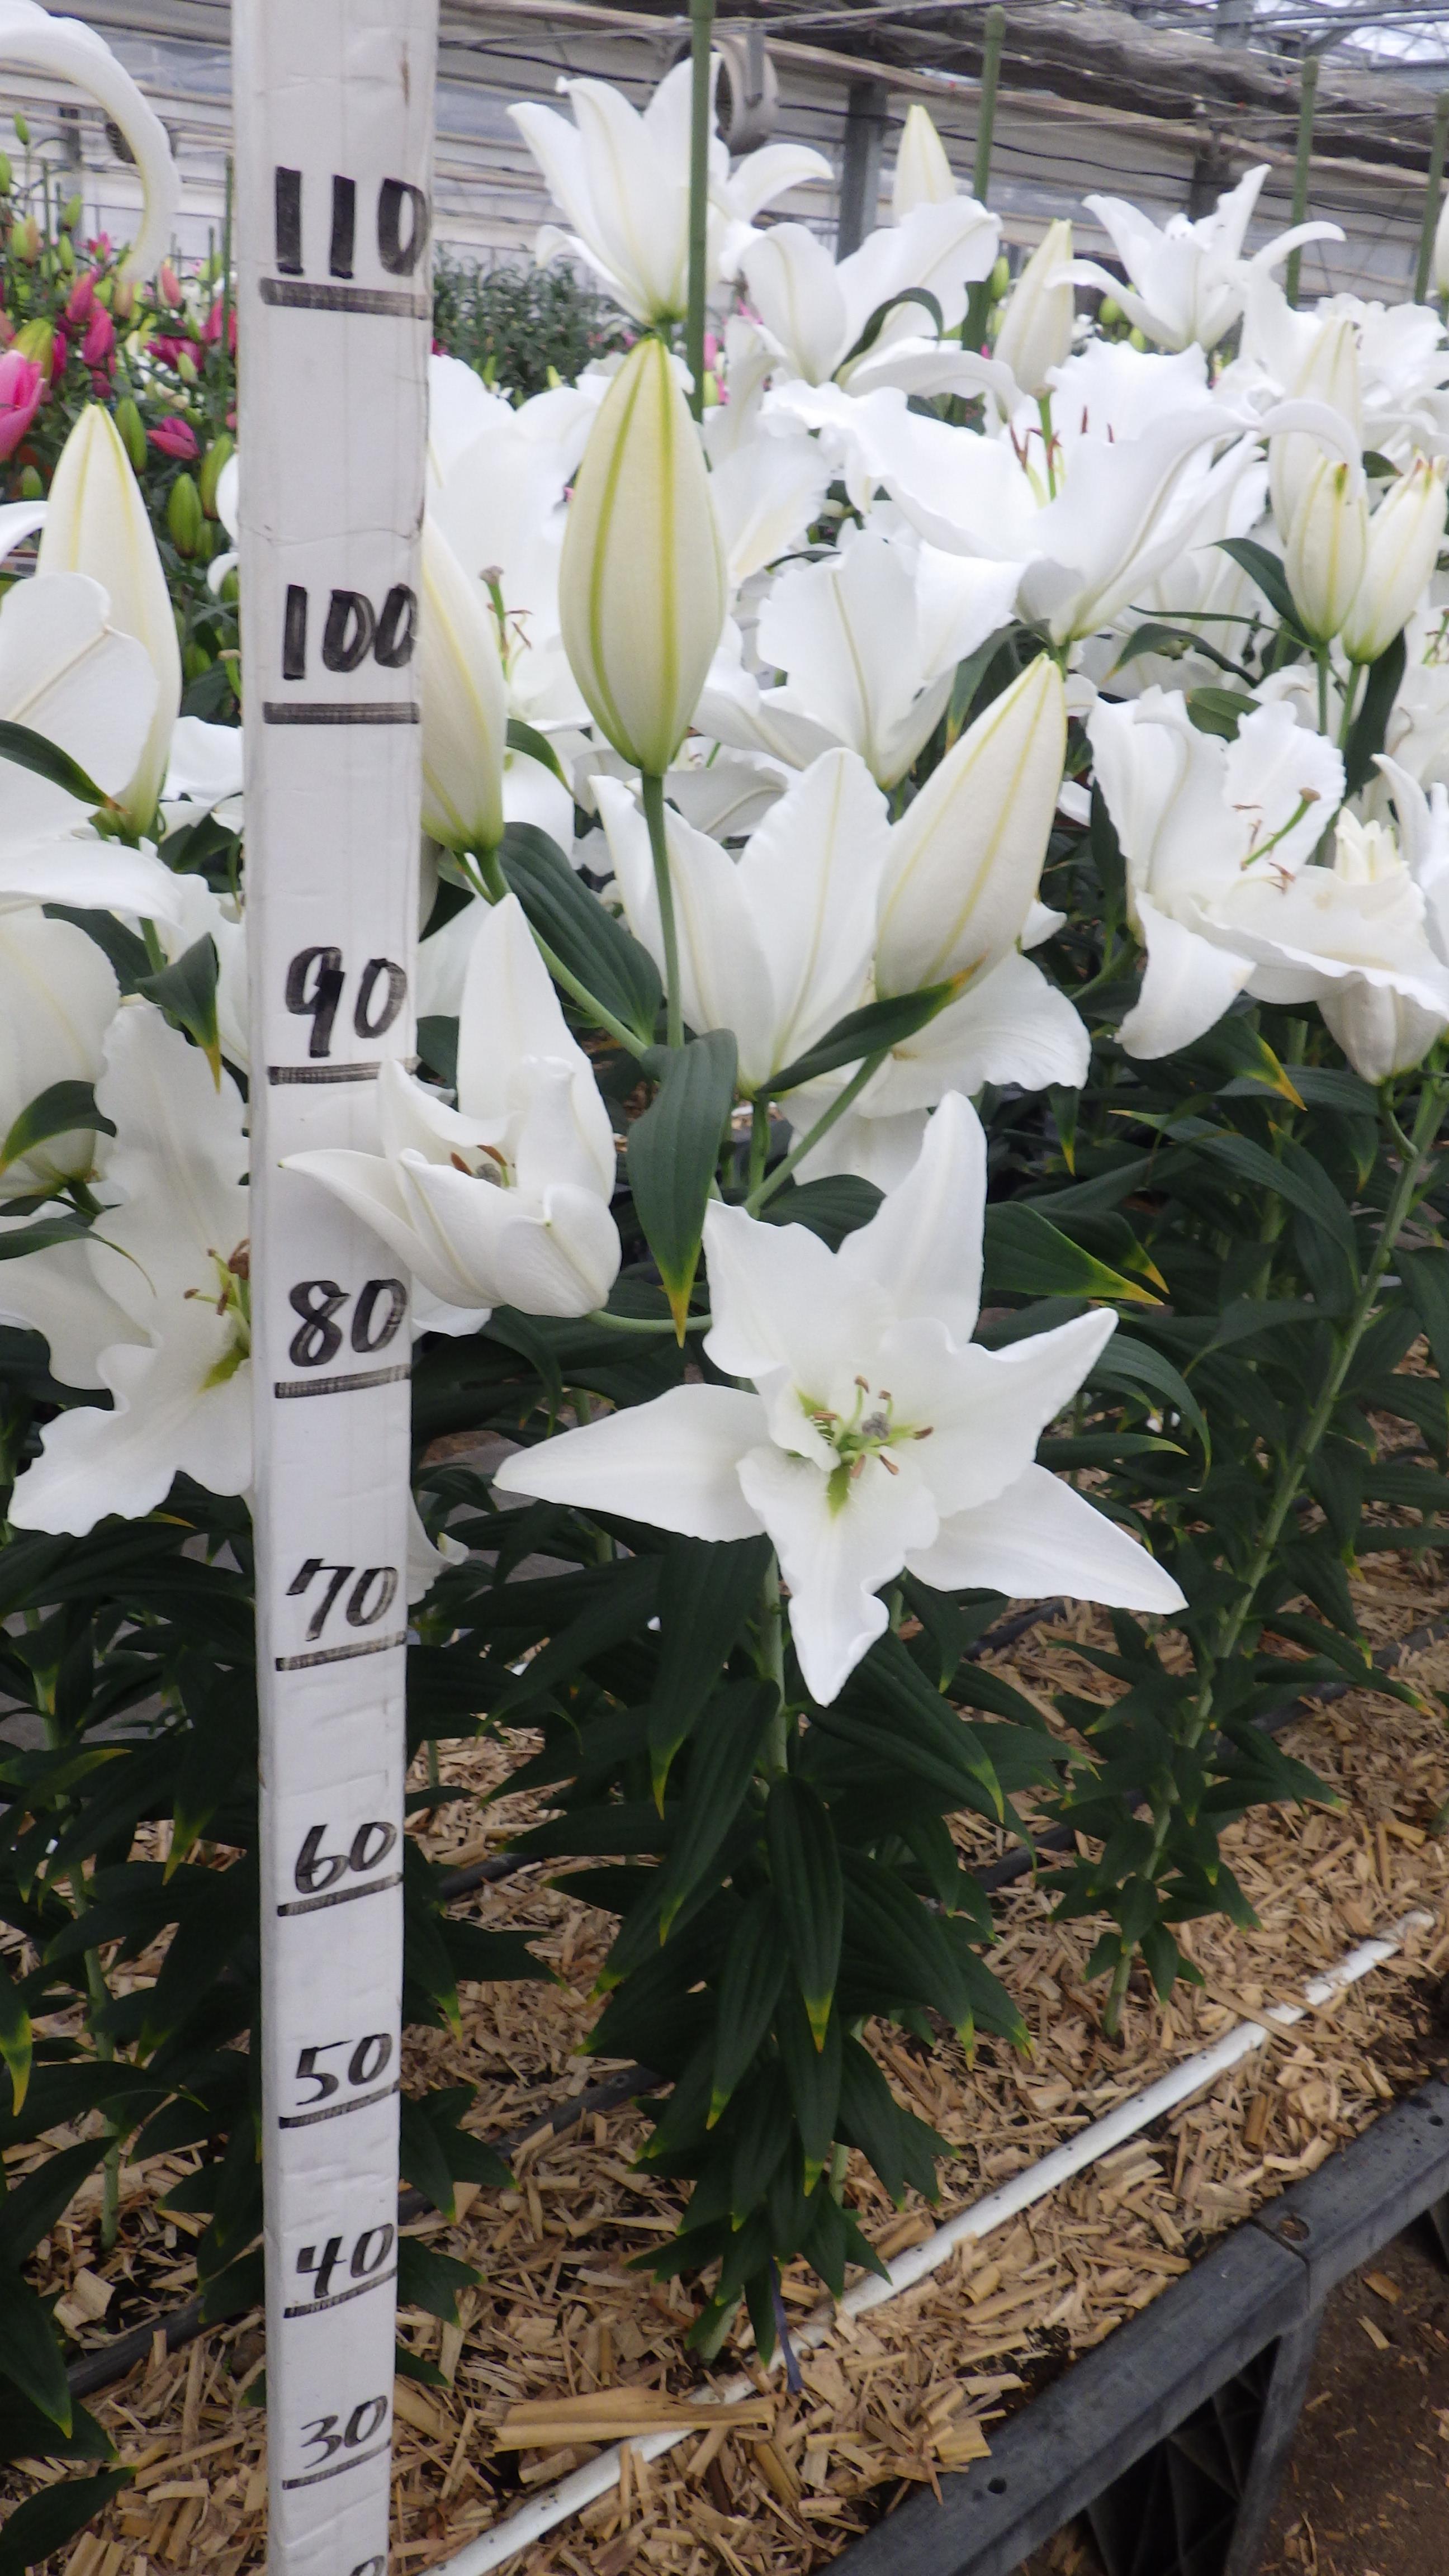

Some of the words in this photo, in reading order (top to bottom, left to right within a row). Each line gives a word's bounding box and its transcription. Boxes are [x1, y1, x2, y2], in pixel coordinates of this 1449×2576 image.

[275, 166, 427, 280] 110
[283, 583, 418, 681] 100
[286, 946, 405, 1058] 90
[289, 1278, 408, 1367] 80
[286, 1557, 397, 1642] 70
[294, 1821, 396, 1894] 60
[296, 2033, 392, 2106] 50
[296, 2223, 395, 2299] 40
[300, 2395, 388, 2469] 30
